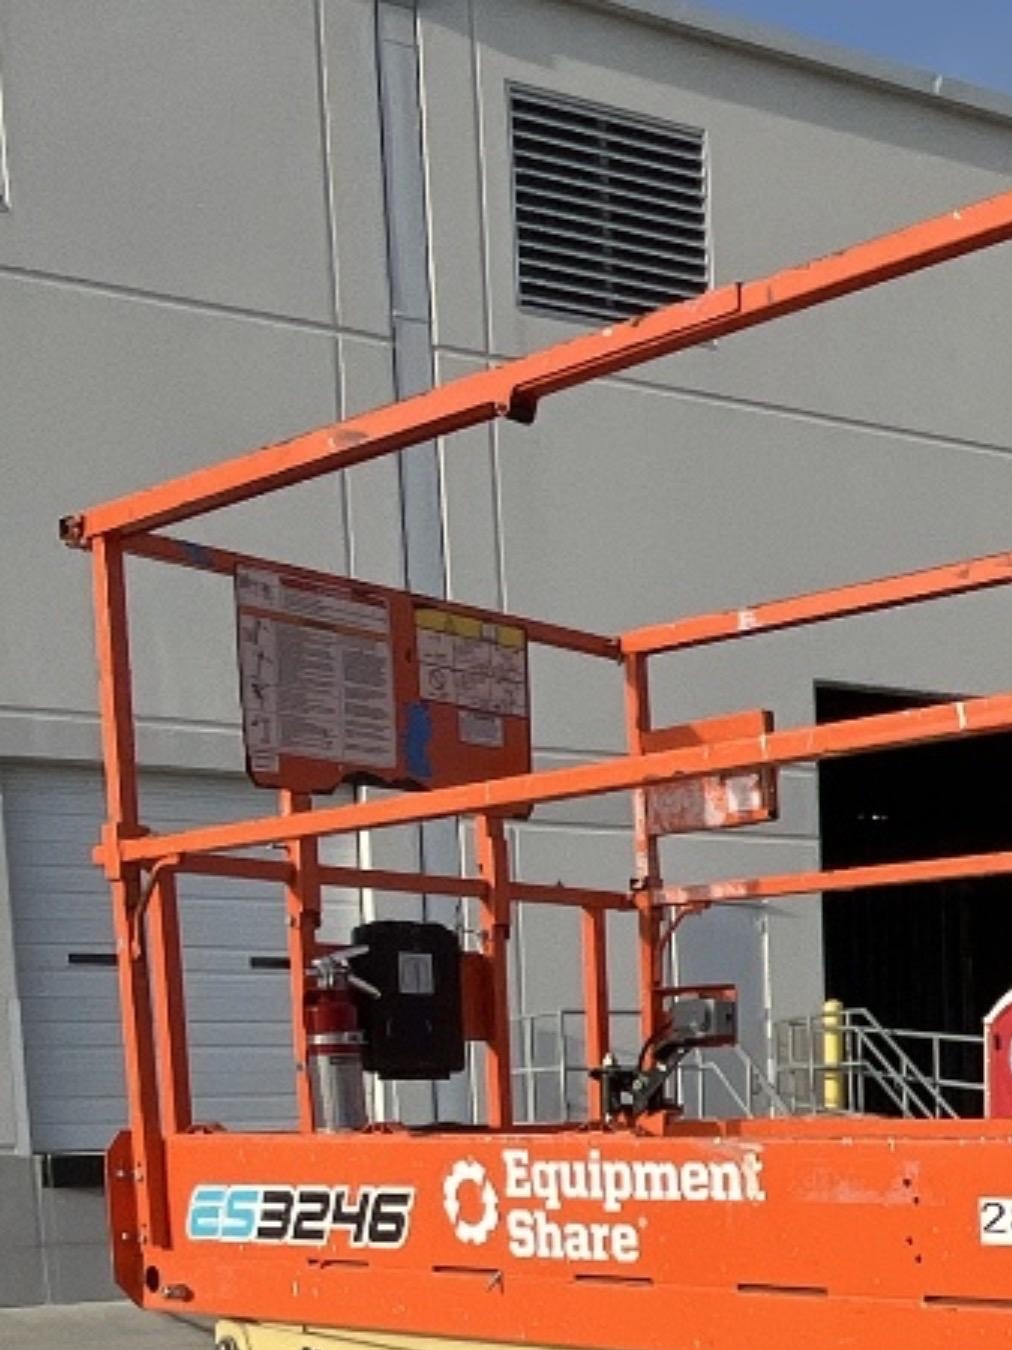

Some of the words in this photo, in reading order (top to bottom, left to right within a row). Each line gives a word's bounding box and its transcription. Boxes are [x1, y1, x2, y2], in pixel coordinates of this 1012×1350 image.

[502, 1149, 766, 1210] Equipment
[187, 1183, 415, 1248] ES3246
[508, 1209, 640, 1262] Share
